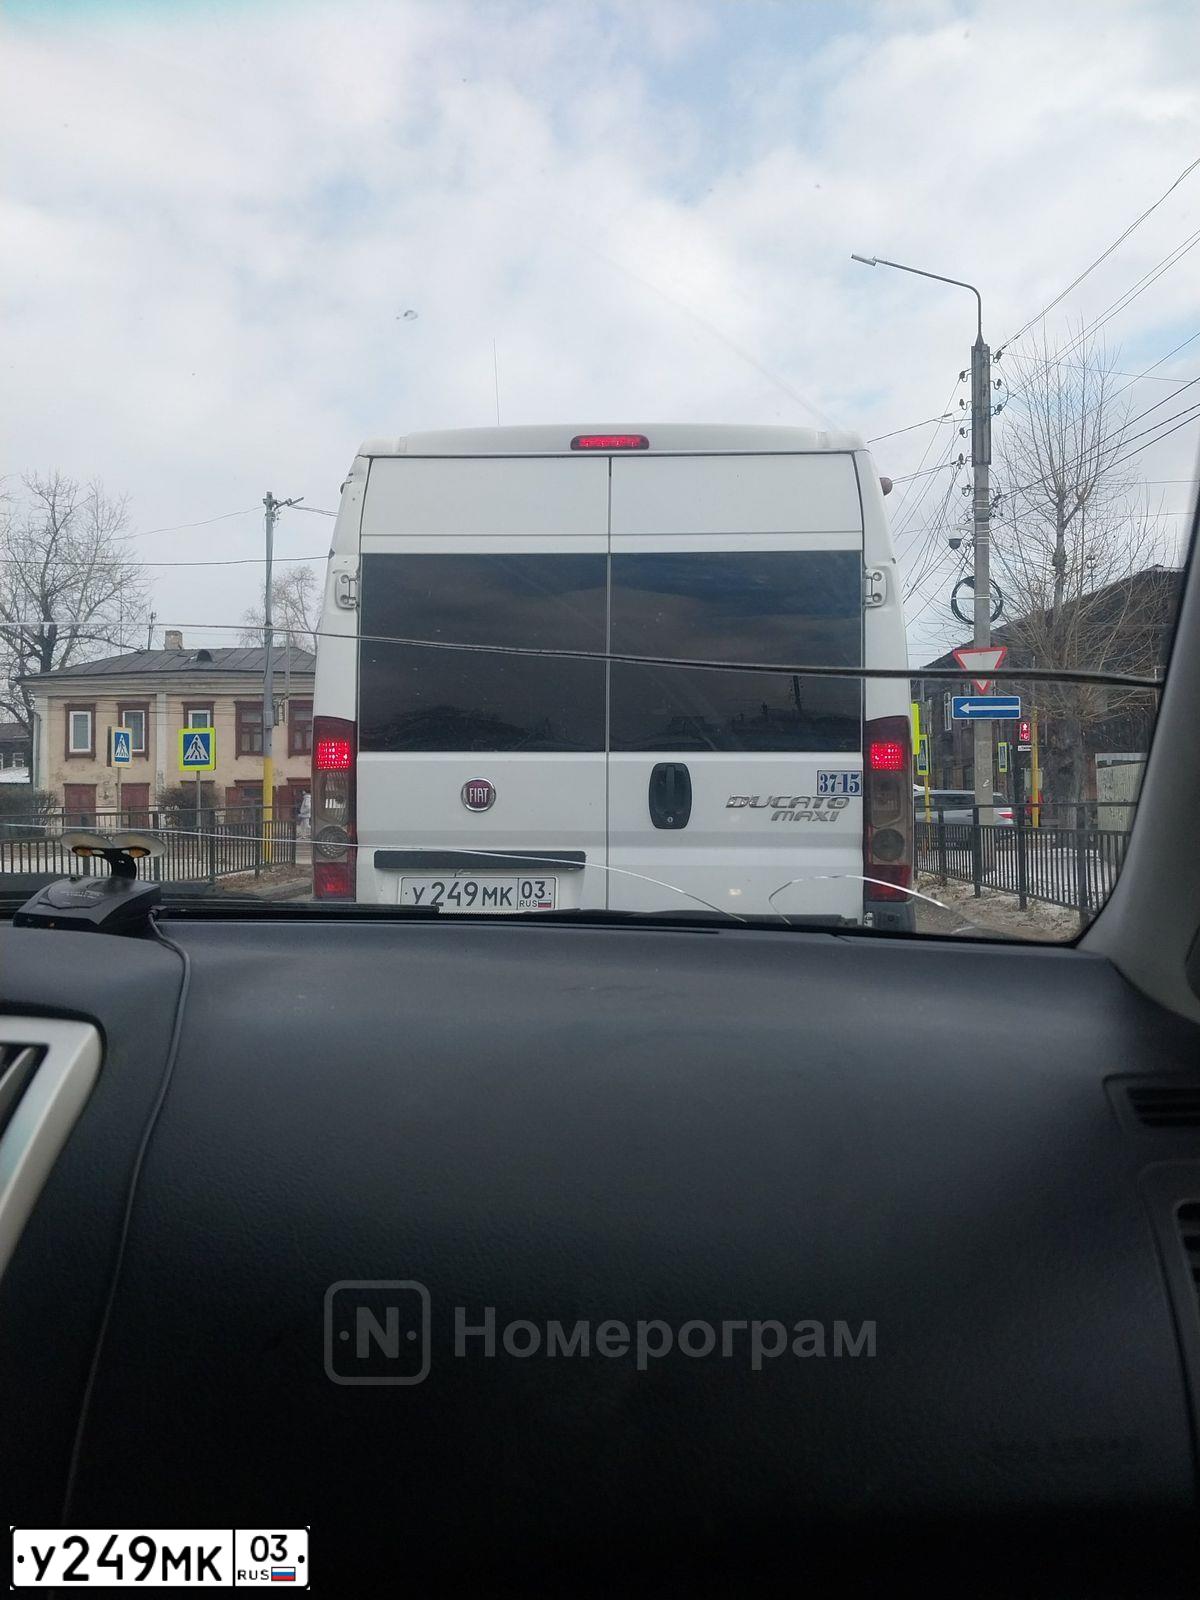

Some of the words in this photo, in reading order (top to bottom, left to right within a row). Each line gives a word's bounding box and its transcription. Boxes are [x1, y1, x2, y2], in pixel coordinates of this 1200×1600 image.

[819, 773, 860, 794] 37-15
[469, 787, 489, 803] FIAT
[725, 795, 850, 810] DUCATO
[771, 810, 840, 822] MAXI
[521, 881, 546, 900] 03
[519, 899, 538, 909] RUS
